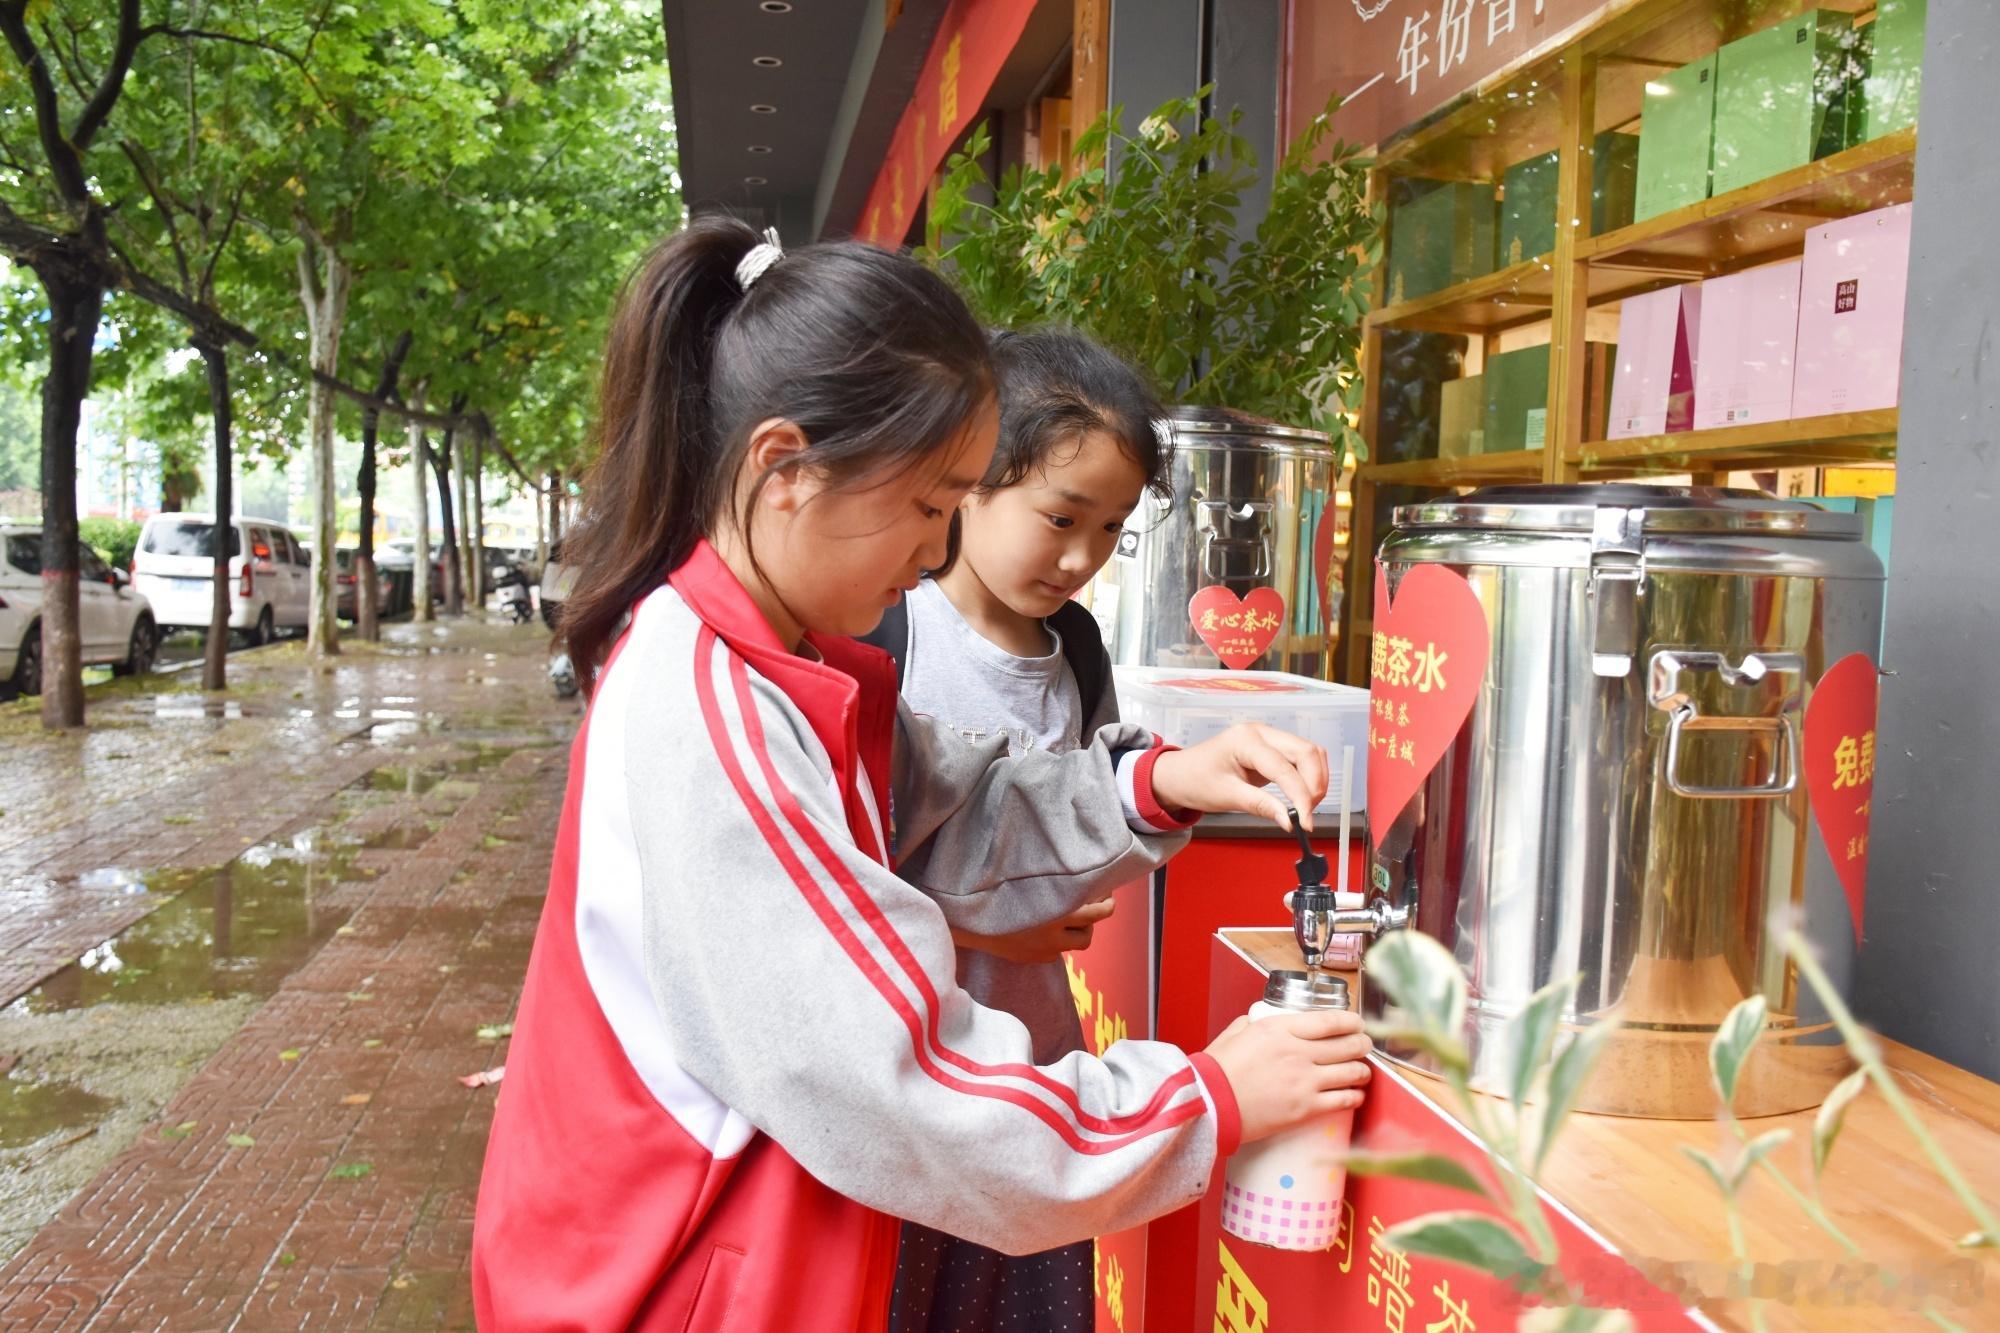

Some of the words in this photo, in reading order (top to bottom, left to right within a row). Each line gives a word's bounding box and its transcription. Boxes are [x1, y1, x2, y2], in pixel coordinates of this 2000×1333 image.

[1200, 608, 1280, 633] 爱心茶水
[1371, 630, 1449, 693] 费茶水
